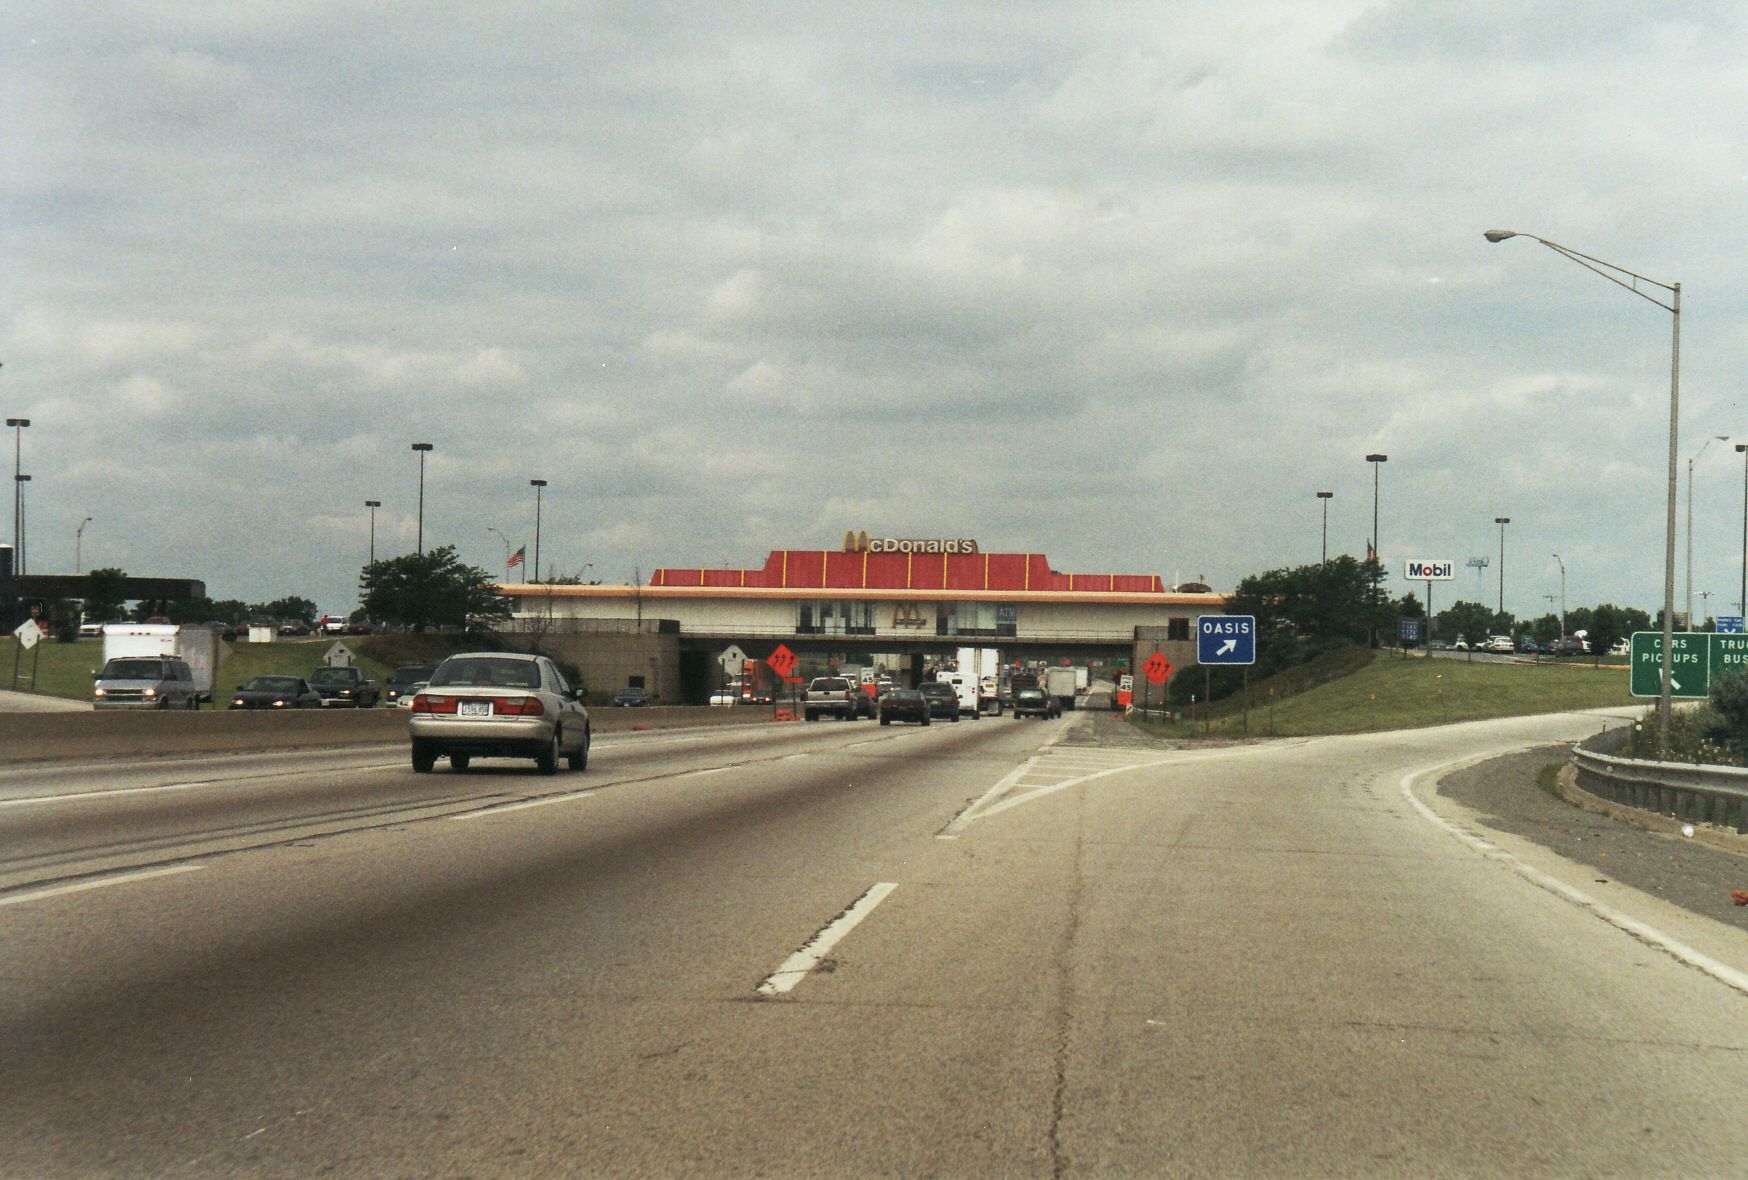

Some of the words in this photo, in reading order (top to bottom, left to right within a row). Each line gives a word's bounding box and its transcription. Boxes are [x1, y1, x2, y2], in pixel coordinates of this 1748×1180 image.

[841, 530, 974, 553] McDonald's
[1409, 563, 1451, 577] Mobil
[1203, 622, 1250, 634] OASIS
[1653, 639, 1687, 649] CRS
[1719, 639, 1748, 650] TRU
[1642, 652, 1699, 664] PICUPS
